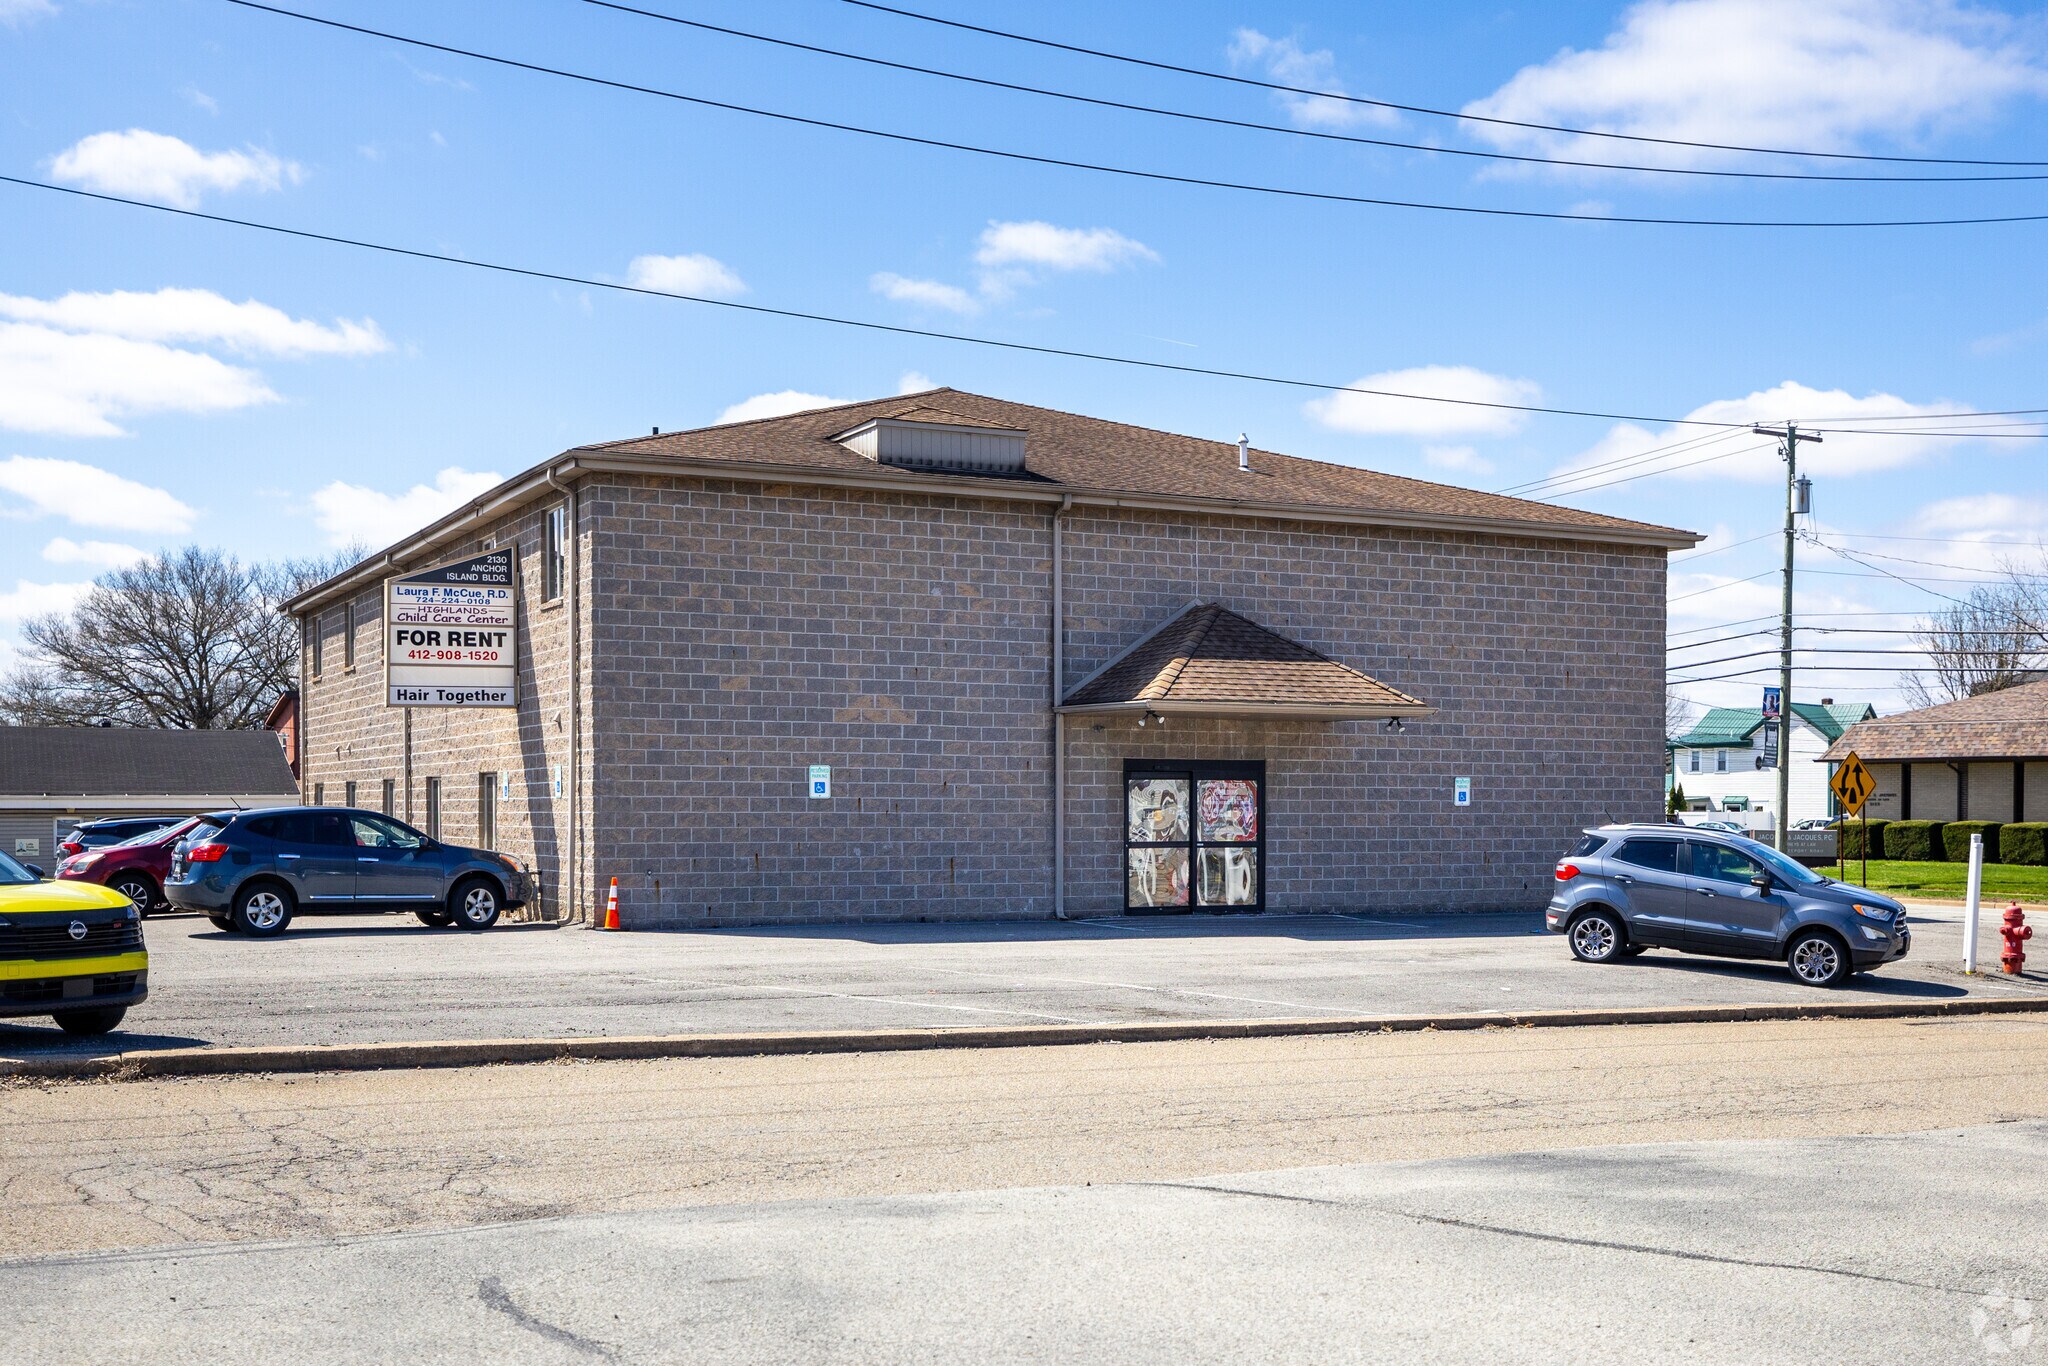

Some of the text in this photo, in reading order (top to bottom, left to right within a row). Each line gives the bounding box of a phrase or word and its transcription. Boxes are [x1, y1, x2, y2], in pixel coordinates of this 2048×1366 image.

[487, 556, 507, 564] 2130
[470, 565, 508, 573] ANCHOR
[446, 573, 508, 582] ISLAND BLDG.
[396, 587, 509, 599] Laura F. McCue, R.D.
[416, 597, 491, 605] 724-224-0108
[417, 606, 488, 614] HIGHLANDS
[397, 612, 508, 624] Child Care Center
[396, 630, 507, 648] FOR RENT
[408, 649, 498, 661] 412-908-1520
[396, 688, 507, 704] Hair Together
[1757, 833, 1775, 841] JACQ
